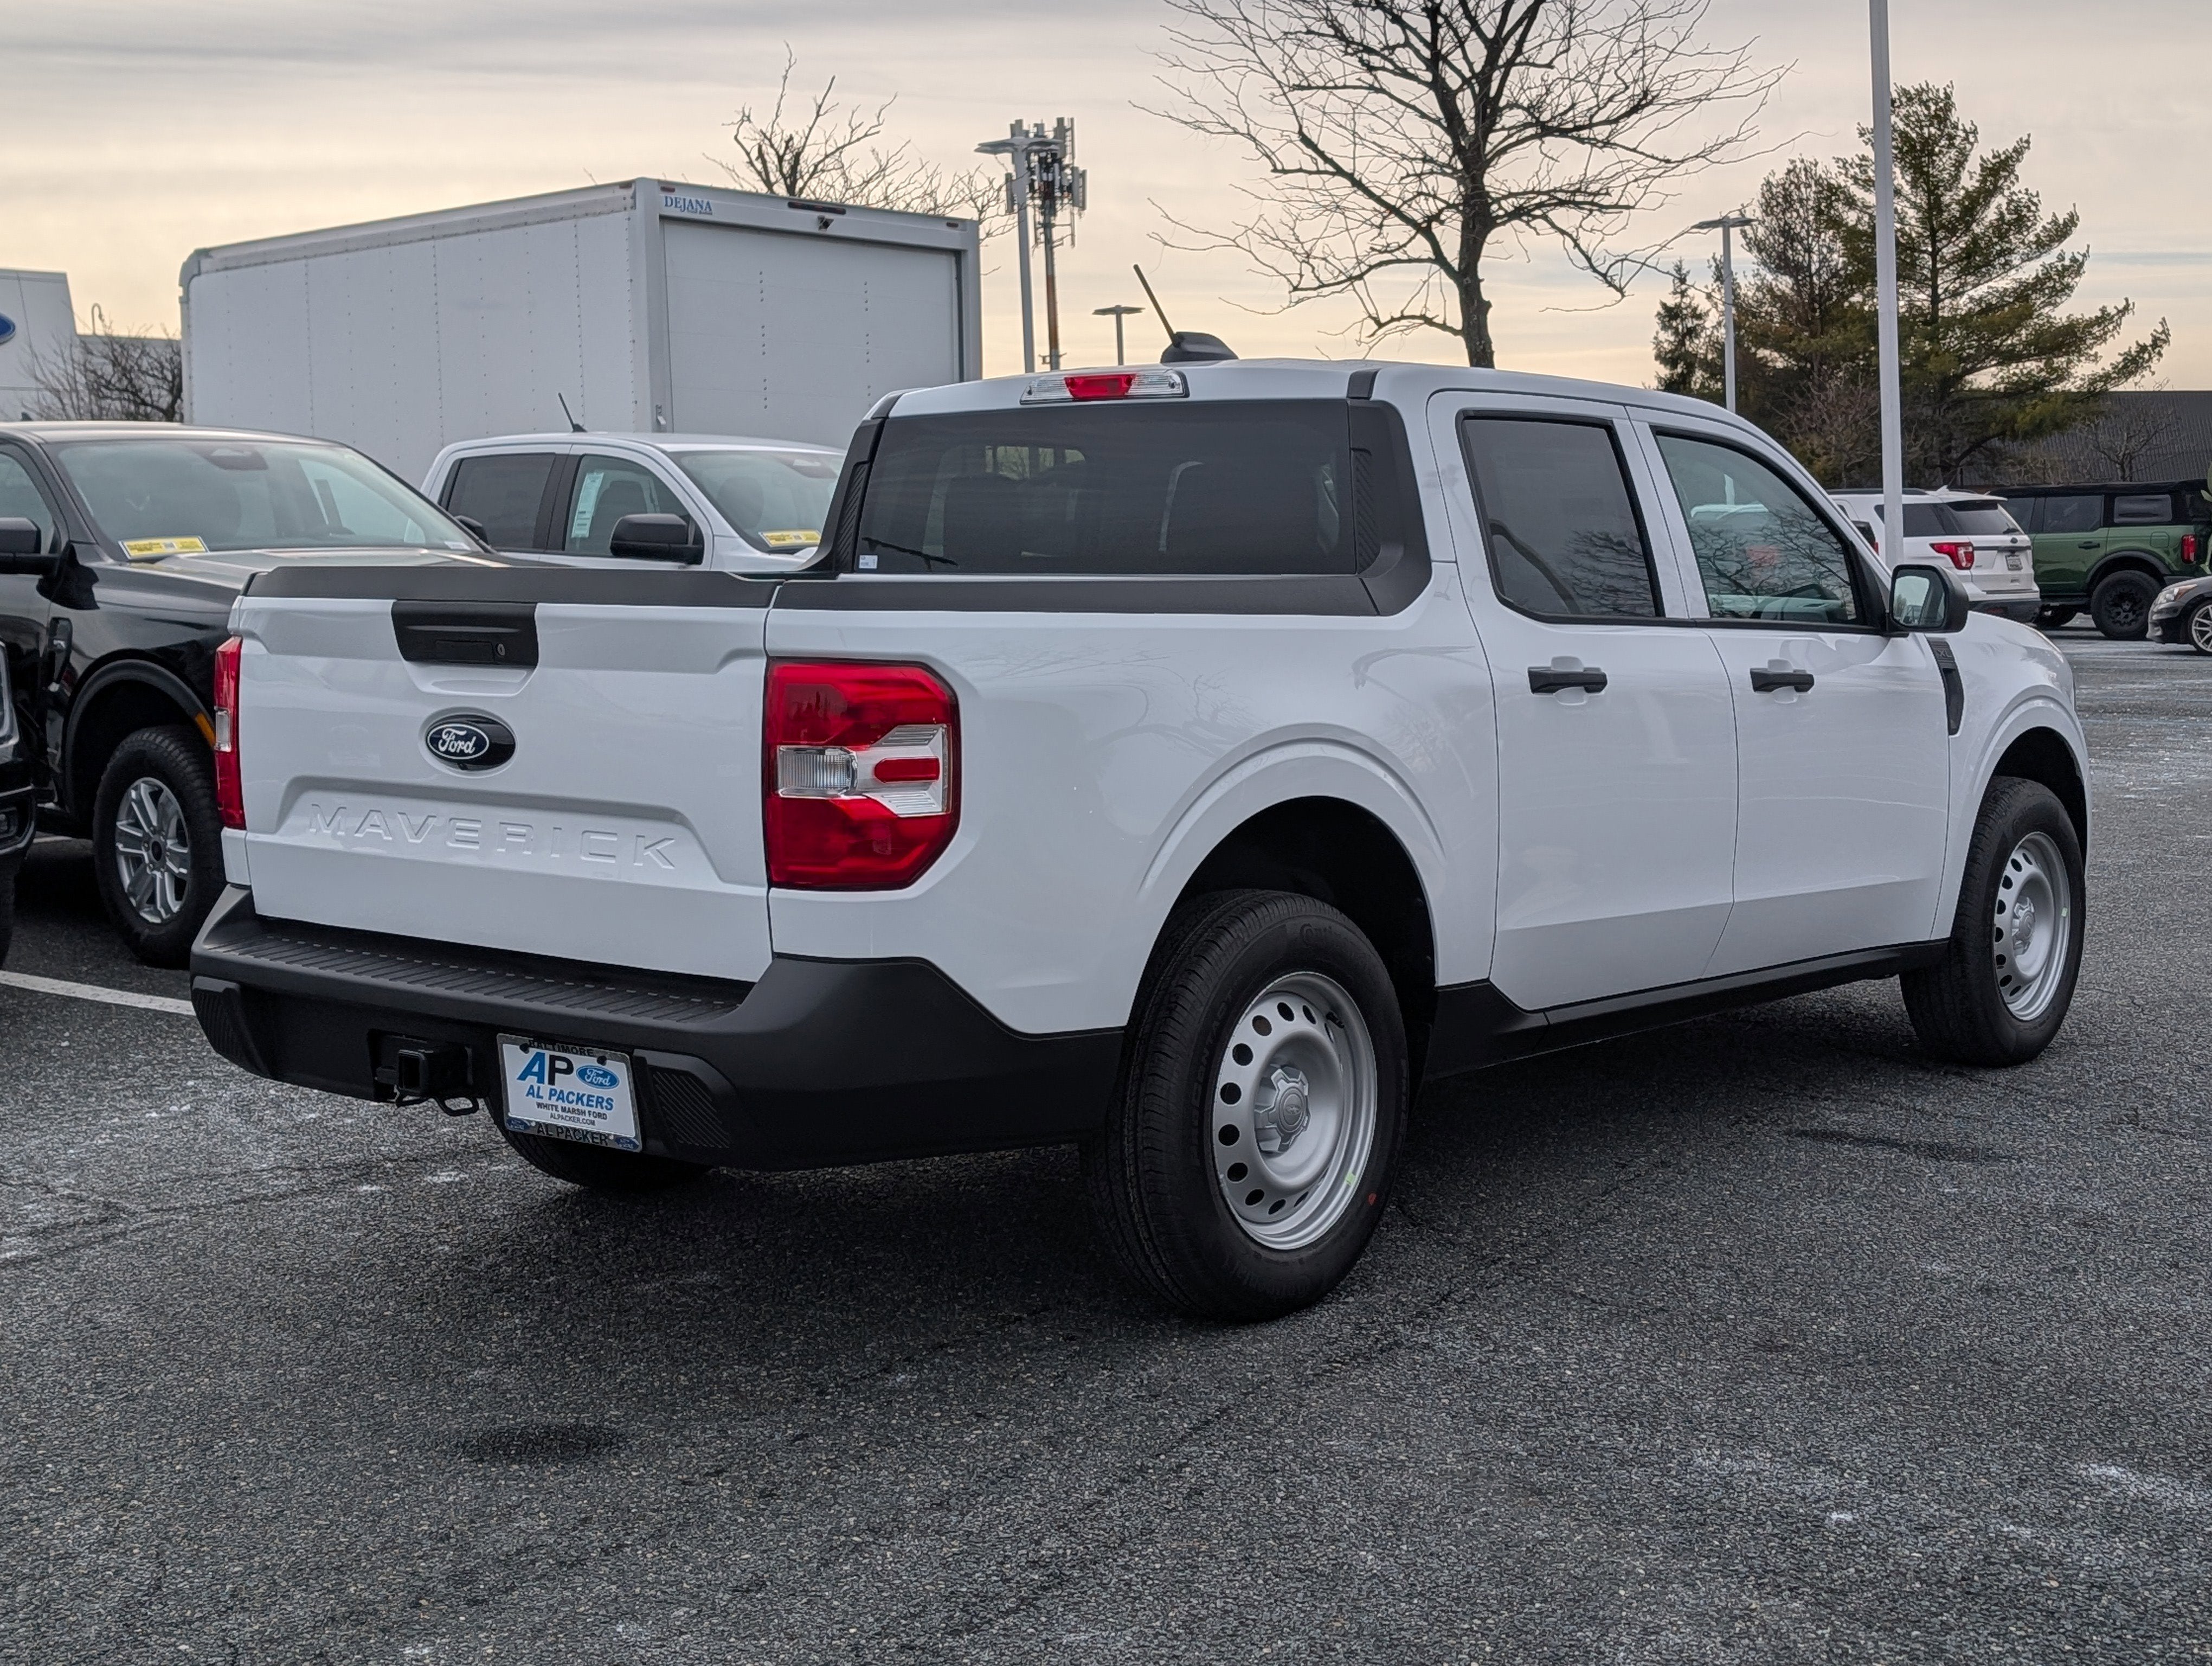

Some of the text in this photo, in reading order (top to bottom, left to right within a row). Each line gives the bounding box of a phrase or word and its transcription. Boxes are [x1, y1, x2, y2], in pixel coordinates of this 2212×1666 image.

[665, 196, 712, 212] DEJANA
[438, 728, 476, 754] Ford
[310, 804, 675, 869] MAVERICK
[517, 1051, 611, 1086] AP Ford
[525, 1085, 614, 1111] AL PACKERS
[536, 1101, 607, 1120] WHITE MARSH FORD
[550, 1113, 596, 1126] ALPACKER.COM
[537, 1123, 553, 1136] AL
[557, 1126, 608, 1146] PACKER
